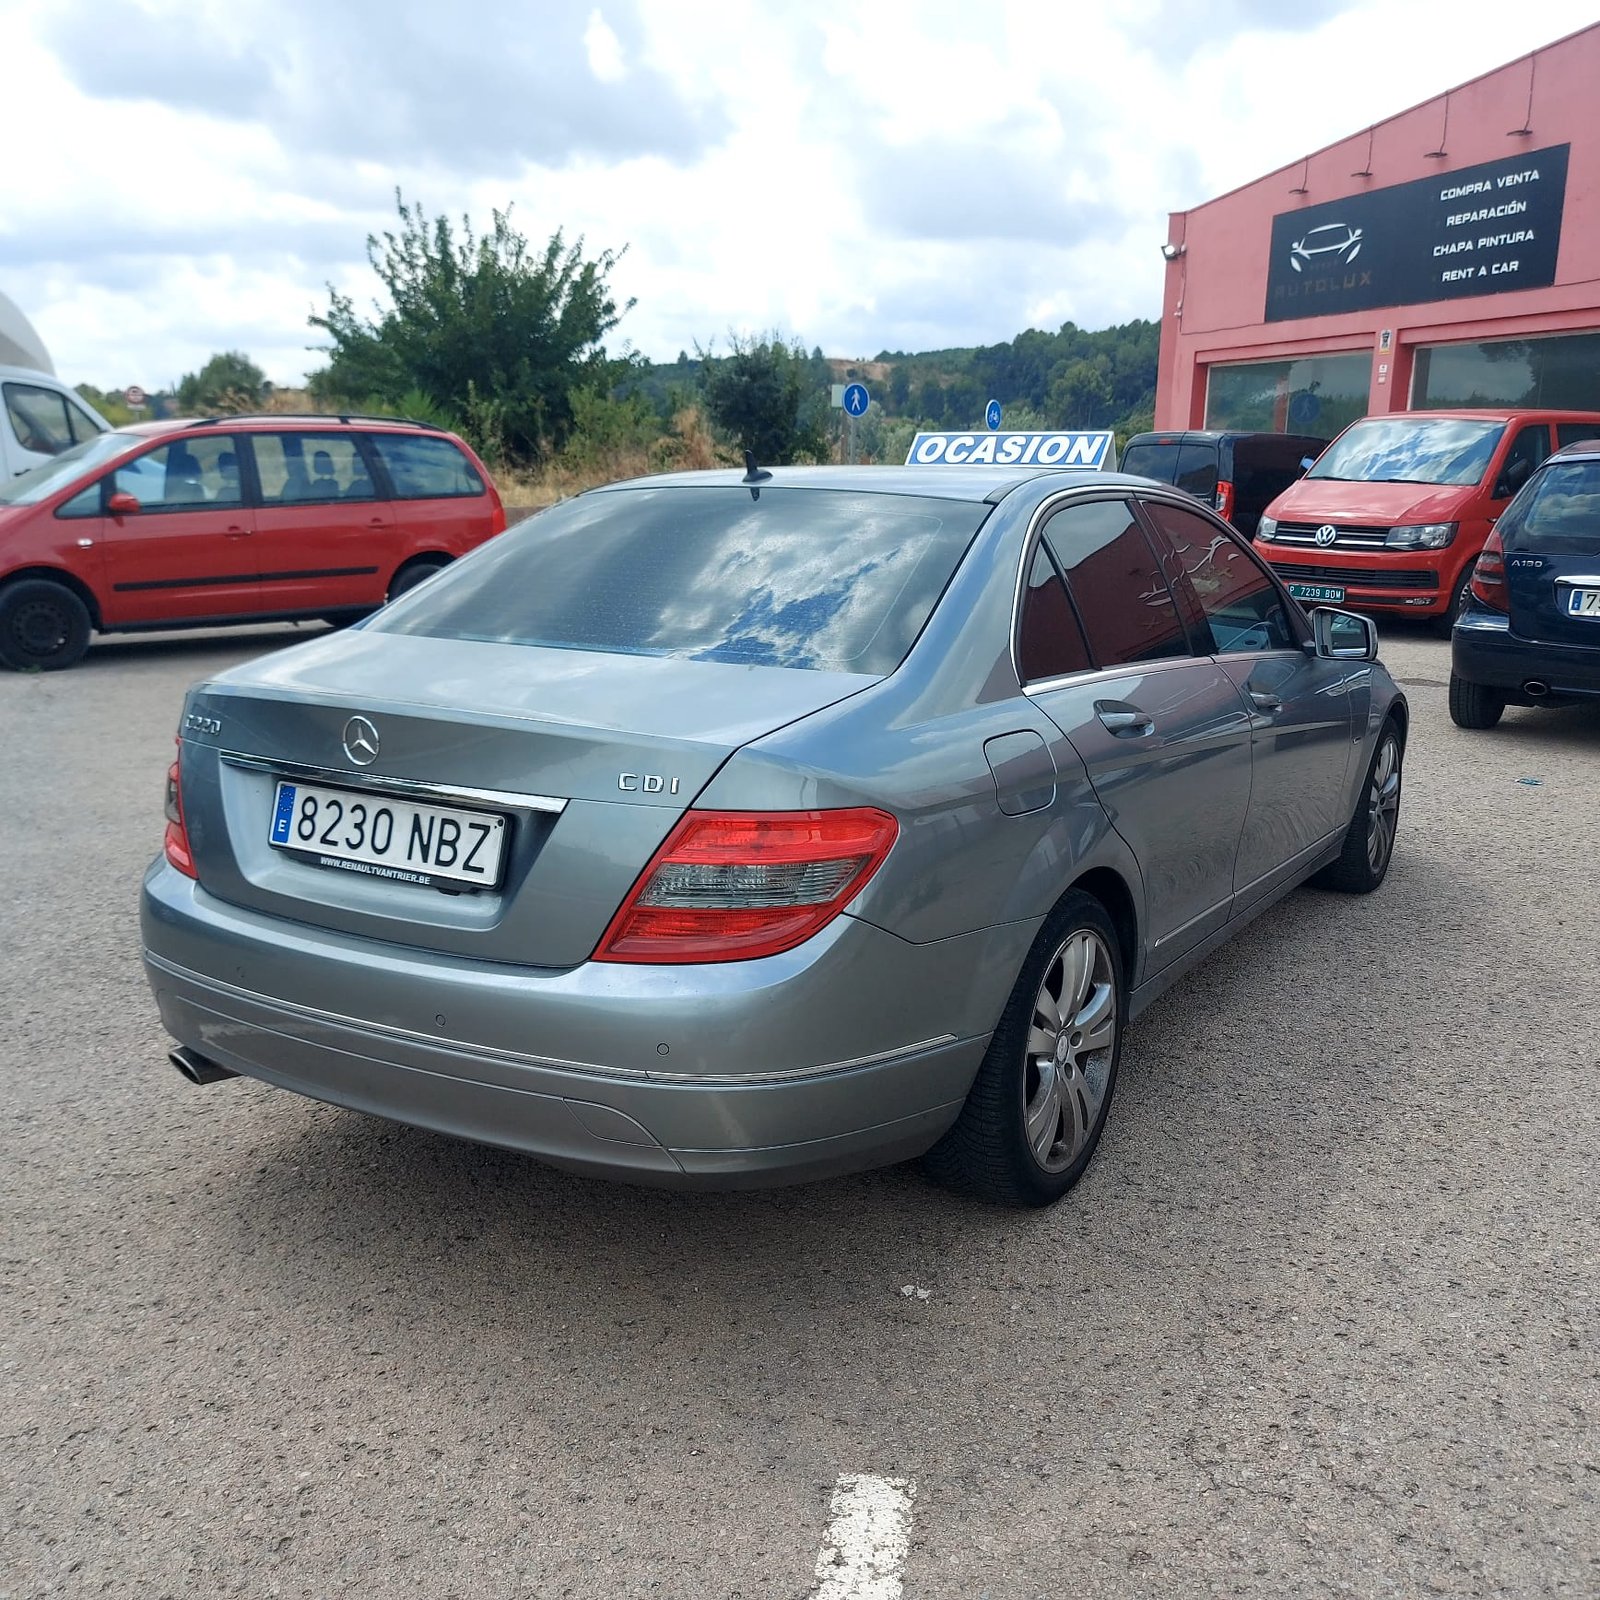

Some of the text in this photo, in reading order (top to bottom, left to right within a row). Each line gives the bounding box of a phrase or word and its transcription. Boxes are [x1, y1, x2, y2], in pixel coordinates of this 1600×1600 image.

[1440, 169, 1540, 201] COMPRA VENTA
[1446, 200, 1527, 227] REPARACIÓN
[1433, 229, 1535, 257] CHAPA PINTURA
[1442, 261, 1519, 282] RENT A CAR
[916, 435, 1105, 465] OCASION
[1300, 587, 1321, 597] 7239
[1586, 594, 1600, 610] 7
[618, 772, 680, 795] CDI
[277, 795, 491, 874] E 8230 NBZ
[320, 856, 431, 886] WWW.RENAULTVANTRIER.BE
